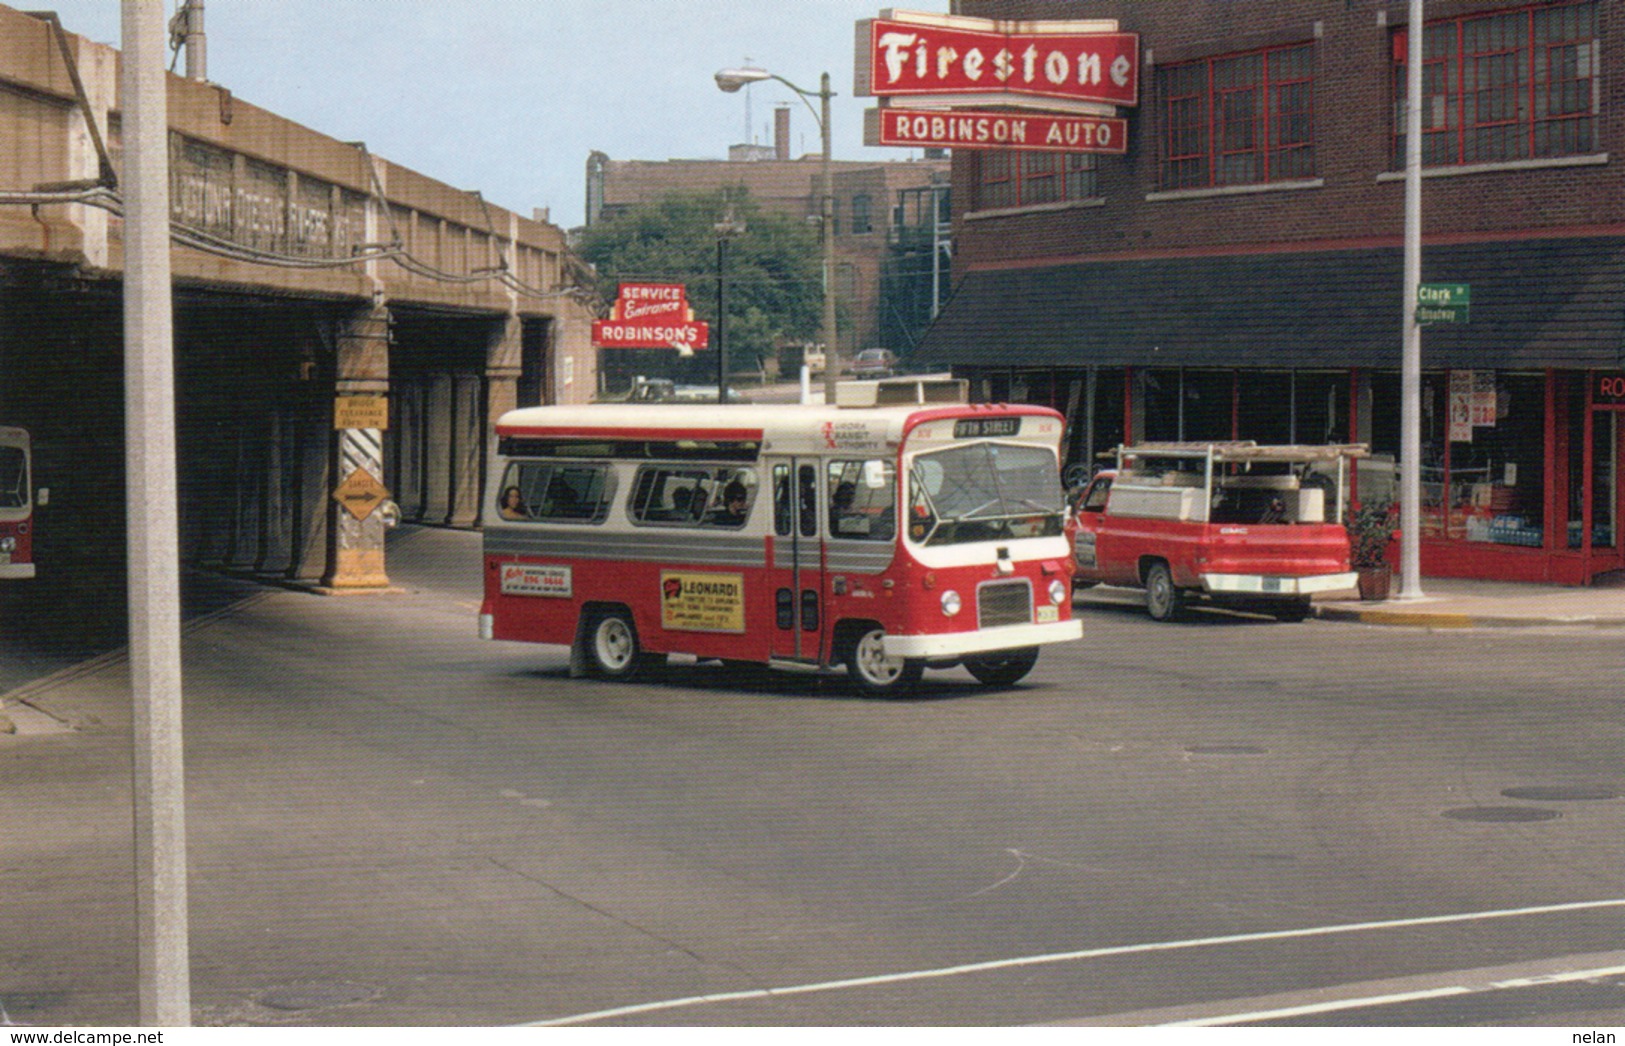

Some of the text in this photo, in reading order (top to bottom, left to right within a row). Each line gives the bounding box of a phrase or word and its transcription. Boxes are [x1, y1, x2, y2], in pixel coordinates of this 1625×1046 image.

[878, 32, 1131, 87] Firestone
[896, 116, 1111, 146] ROBINSON AUTO
[622, 286, 680, 300] SERVICE
[1419, 287, 1451, 300] Clark
[624, 300, 680, 319] Entrance
[602, 325, 698, 342] ROBINSON'S
[684, 581, 738, 596] LEONARDI
